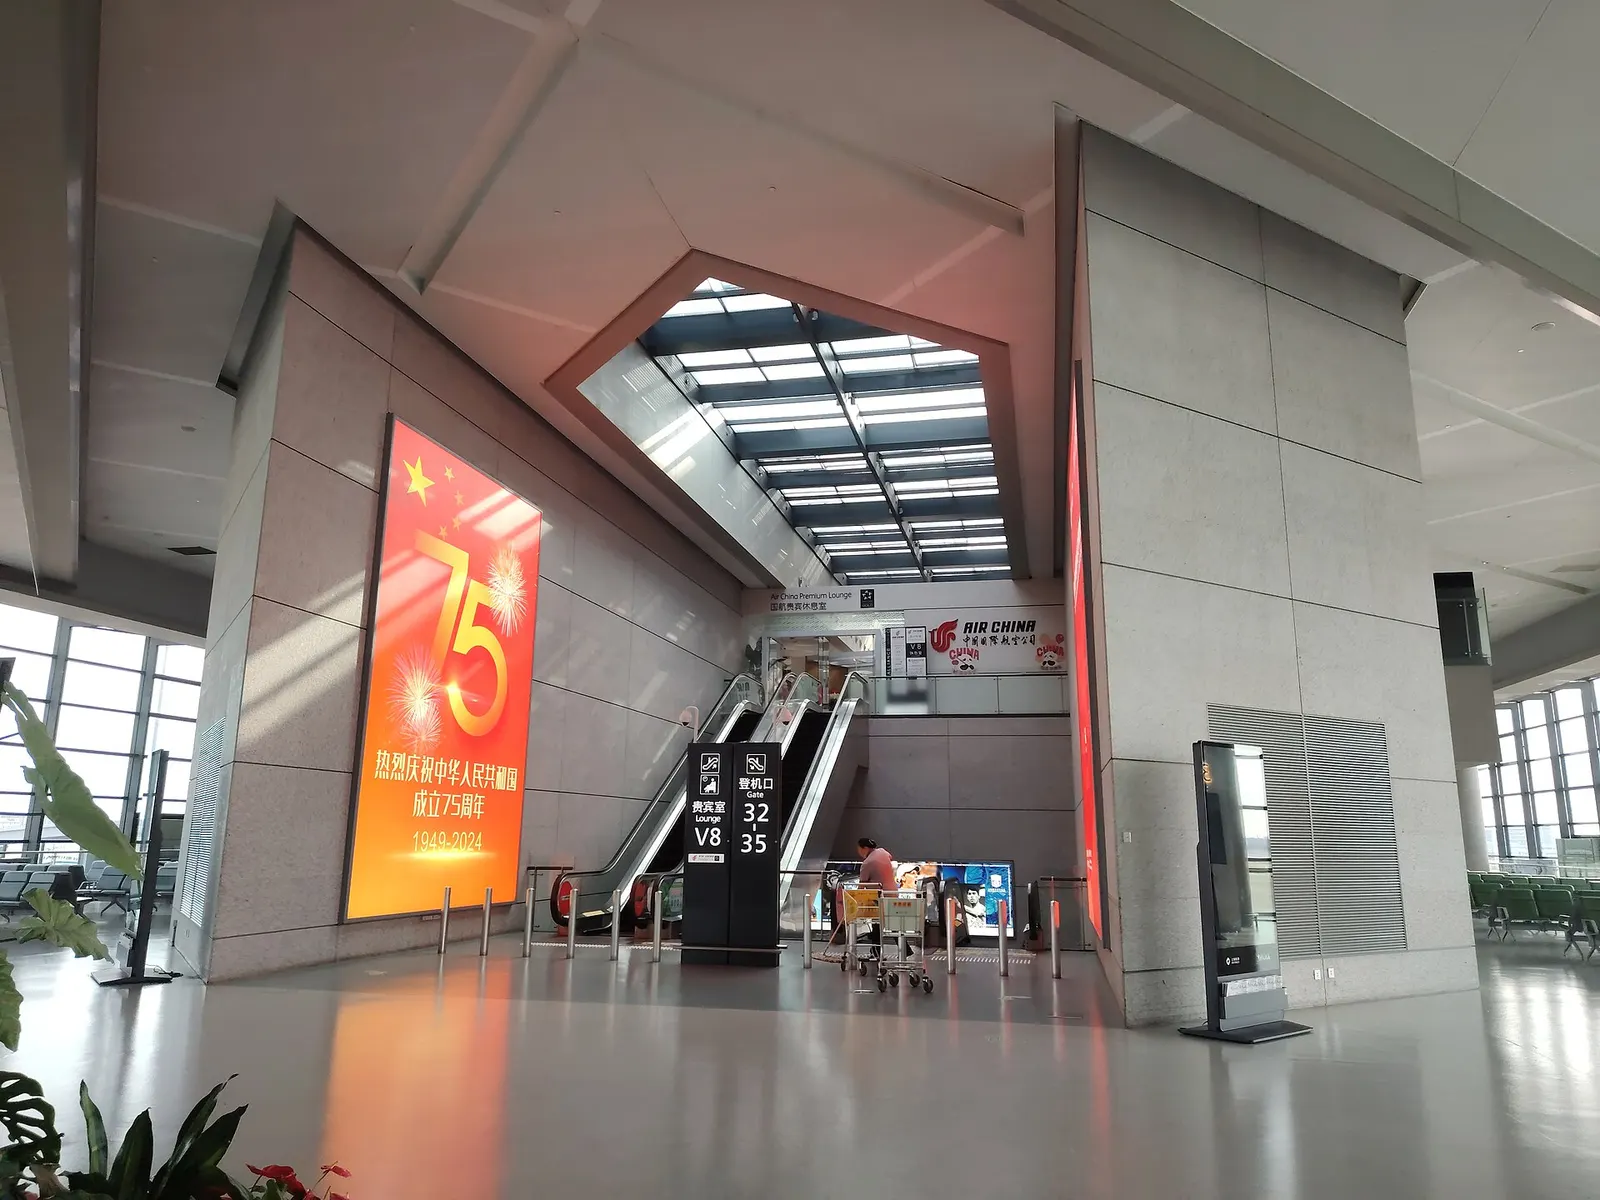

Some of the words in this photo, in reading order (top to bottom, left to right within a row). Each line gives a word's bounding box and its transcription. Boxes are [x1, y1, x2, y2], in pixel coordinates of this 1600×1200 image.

[770, 593, 780, 601] Air
[780, 592, 799, 600] China
[799, 592, 828, 600] Premium
[828, 591, 853, 601] Lounge
[770, 602, 827, 611] 国航贵宾休息室
[413, 528, 510, 737] 75
[962, 621, 988, 634] AIR
[990, 620, 1037, 633] CHINA
[374, 749, 518, 792] 热烈庆祝中华人民共和国
[738, 777, 774, 790] 登机口
[746, 790, 765, 799] Gate
[412, 788, 486, 820] 成立75周年
[691, 800, 726, 814] 贵宾室
[743, 802, 769, 823] 32
[695, 814, 722, 825] Lounge
[412, 830, 483, 853] 1949-2024
[694, 827, 722, 847] V8
[740, 833, 767, 854] 35
